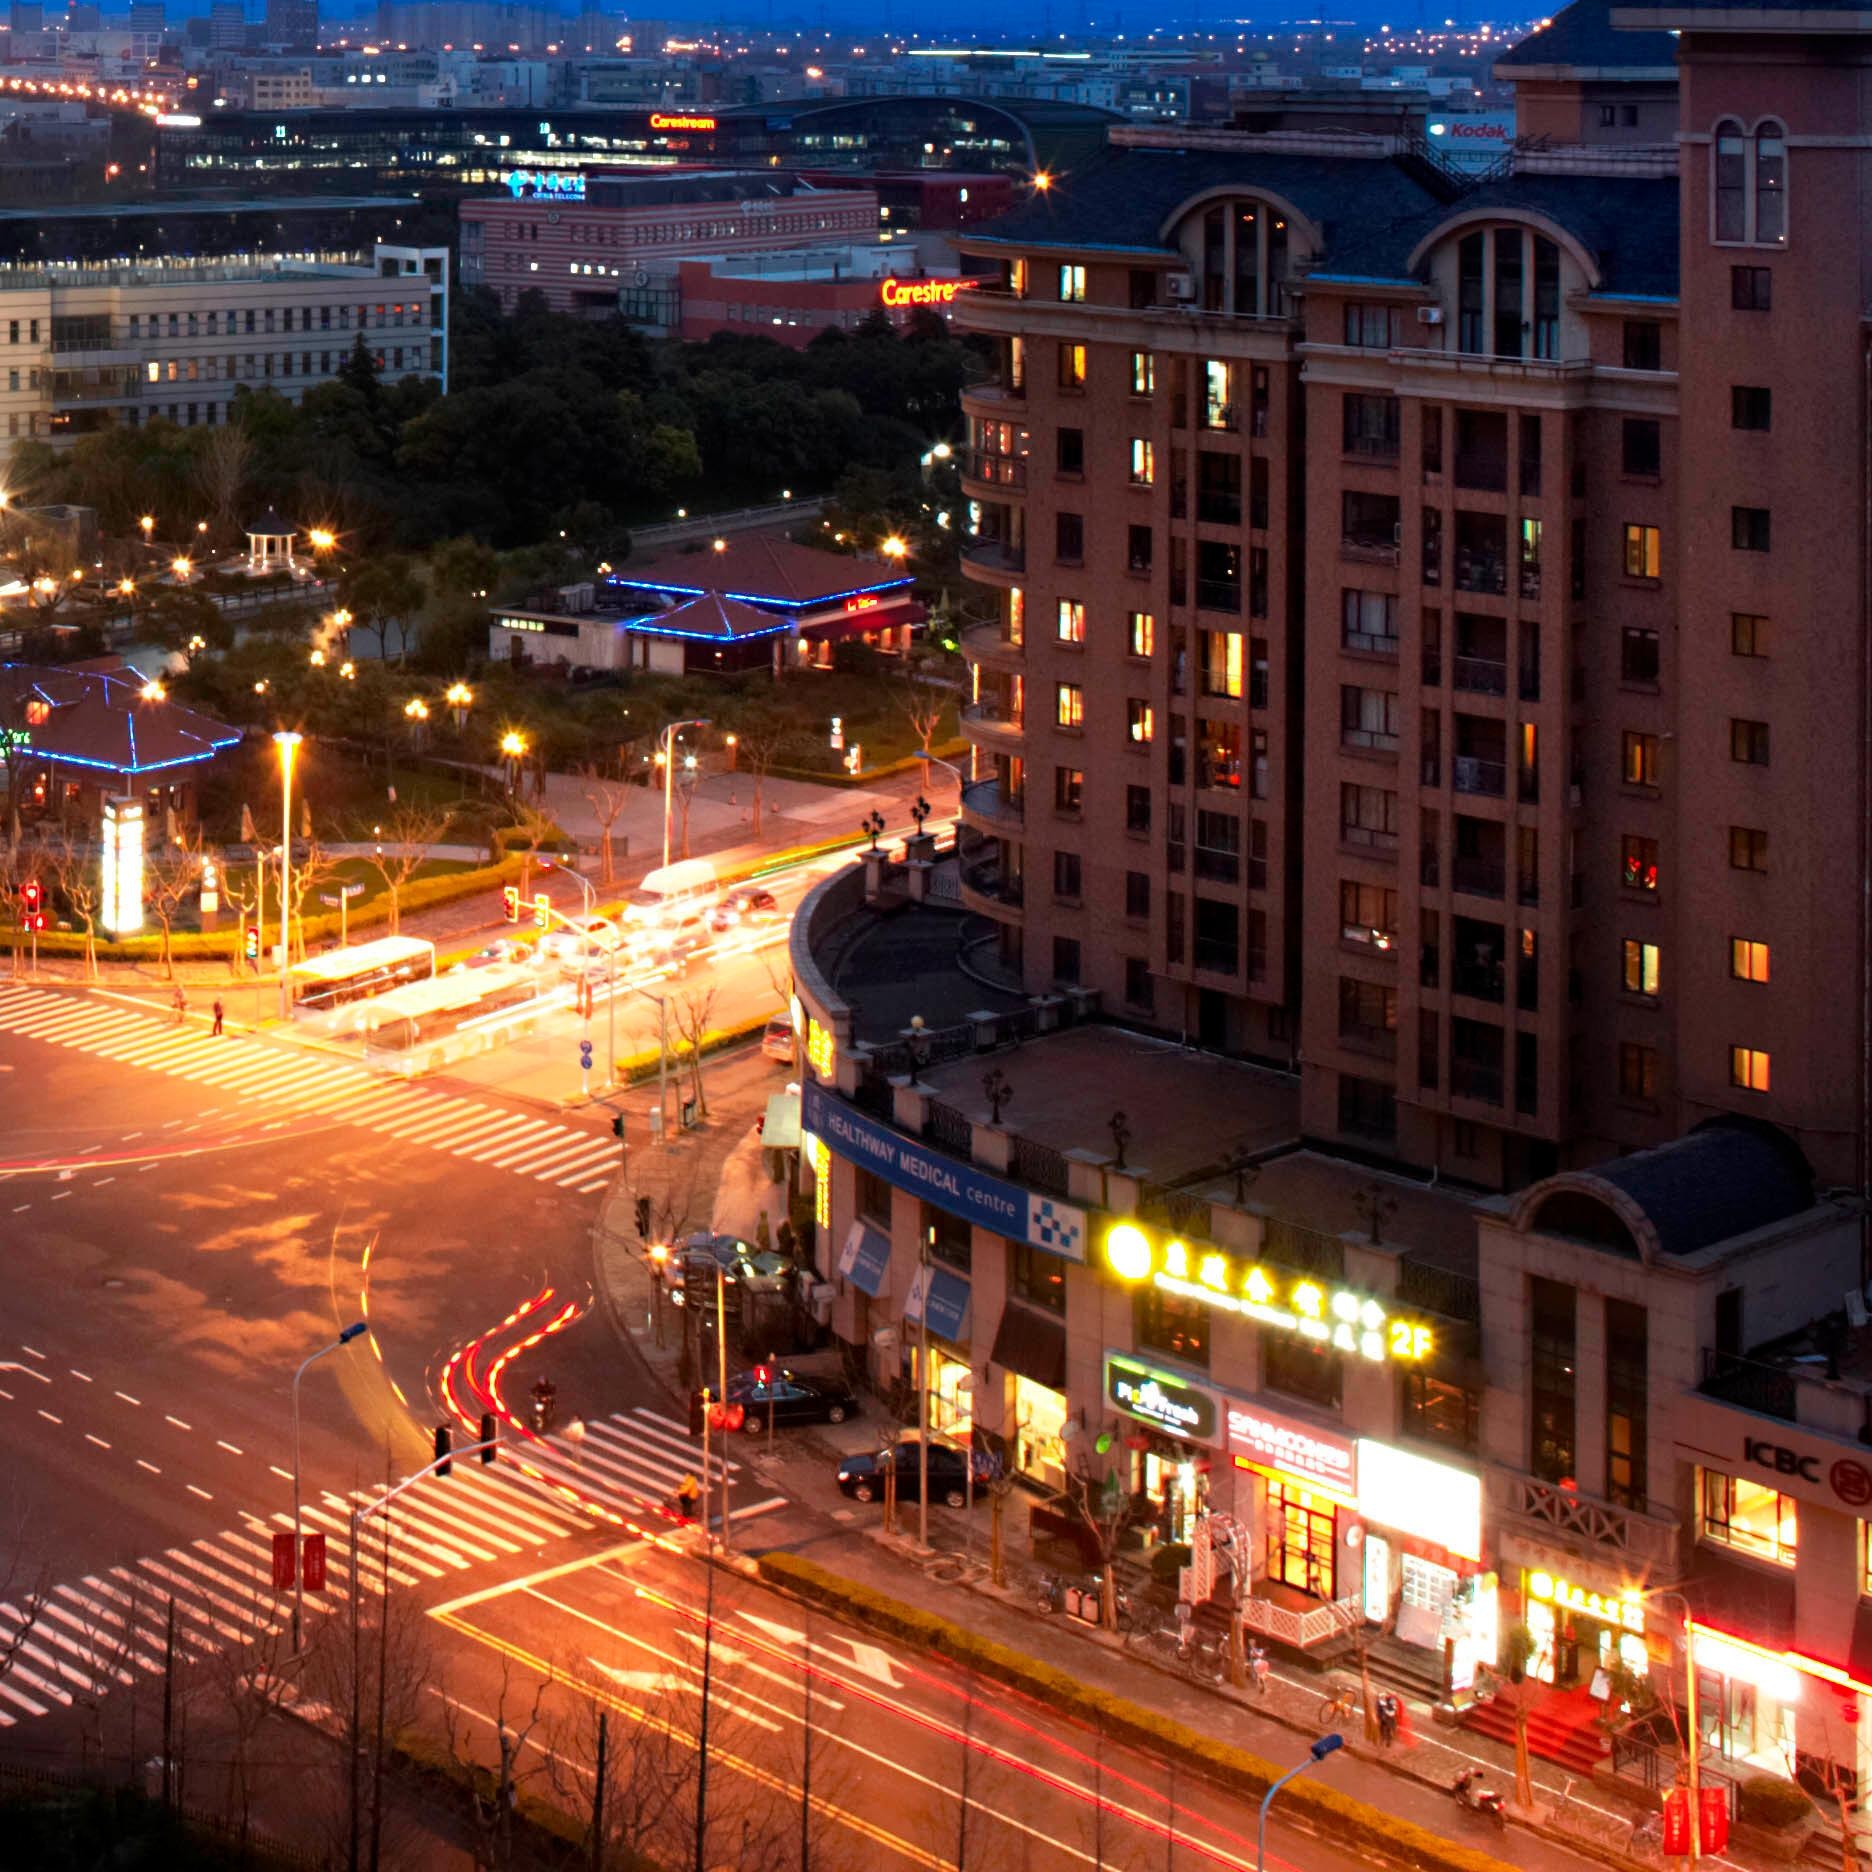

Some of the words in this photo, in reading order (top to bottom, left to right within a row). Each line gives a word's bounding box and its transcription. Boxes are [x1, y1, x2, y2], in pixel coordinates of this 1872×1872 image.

[651, 114, 715, 129] Carestream
[1451, 123, 1505, 138] Kodak
[828, 1112, 896, 1164] HEALTHWAY
[899, 1151, 961, 1197] MEDICAL
[966, 1185, 1016, 1217] centre
[1391, 1319, 1434, 1359] 2F
[1744, 1436, 1821, 1484] ICBC
